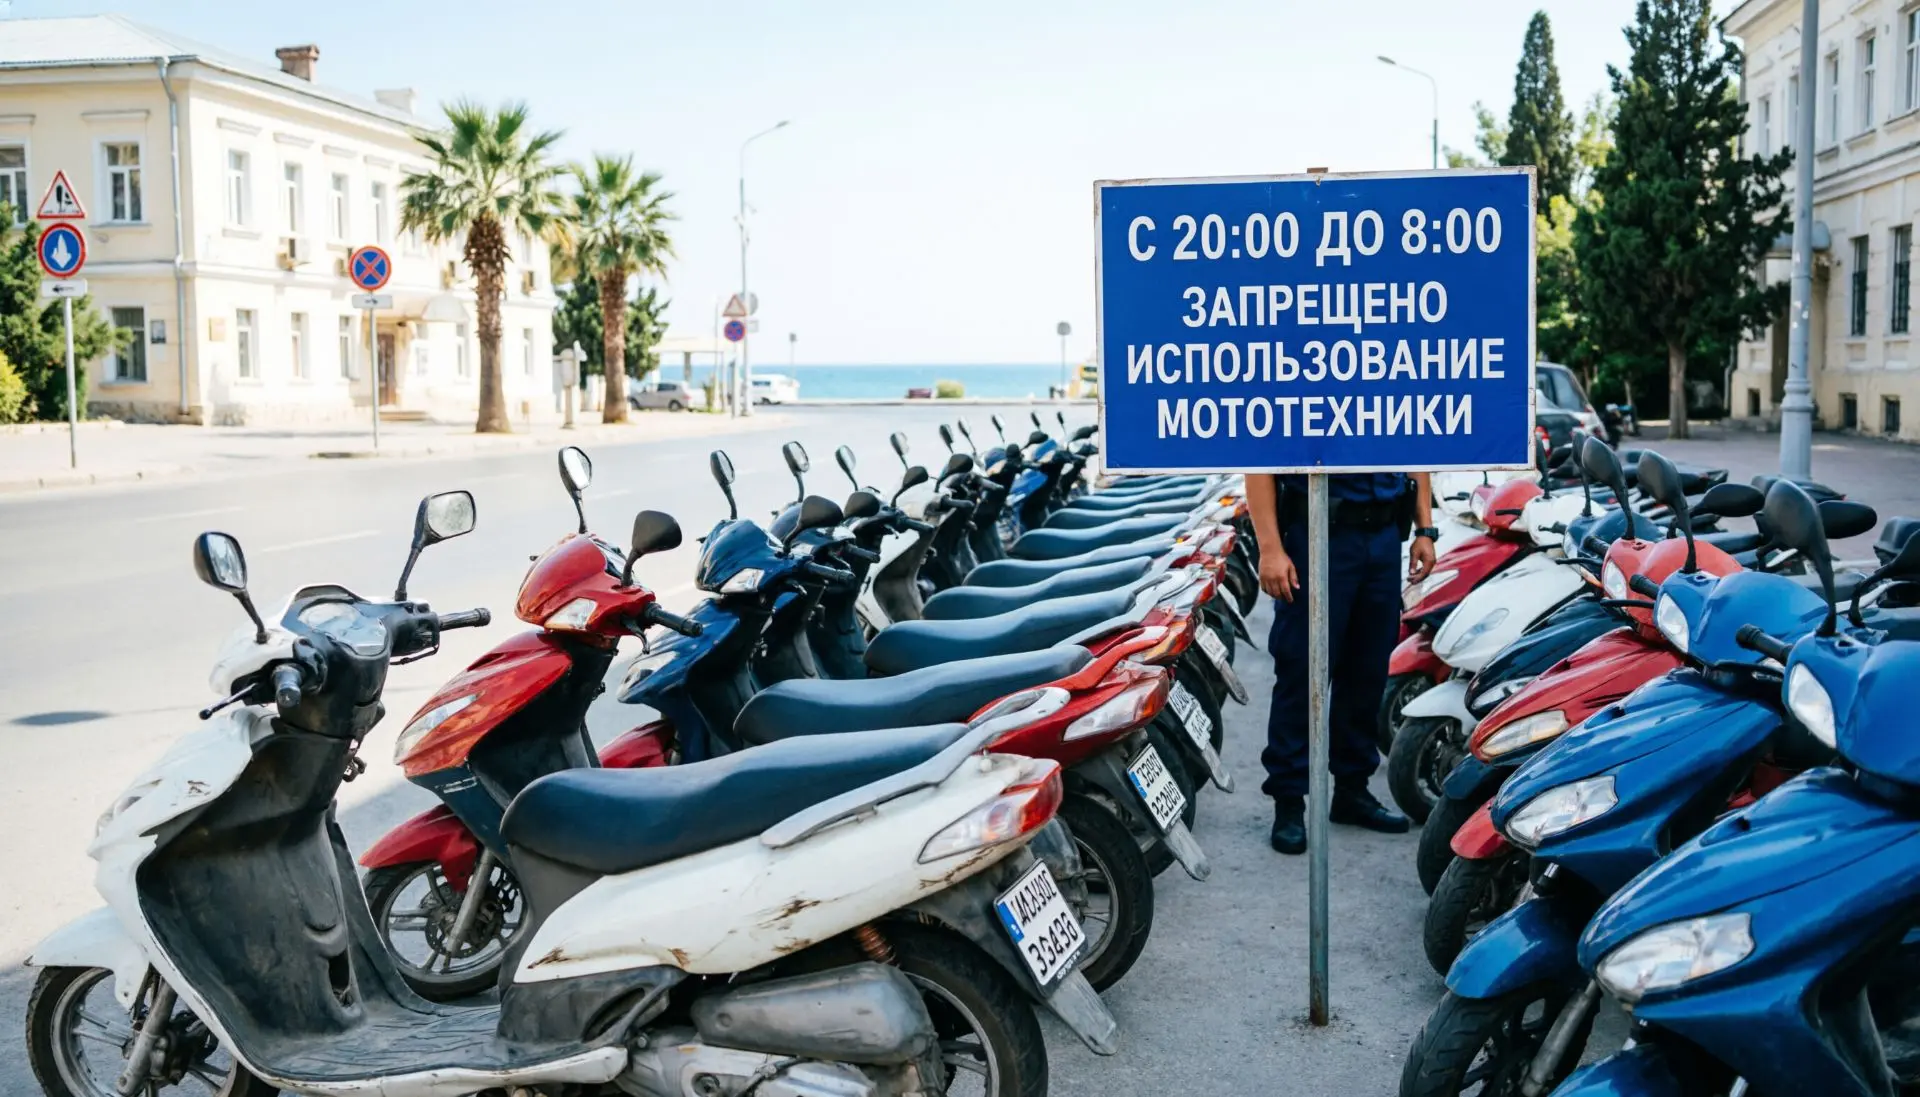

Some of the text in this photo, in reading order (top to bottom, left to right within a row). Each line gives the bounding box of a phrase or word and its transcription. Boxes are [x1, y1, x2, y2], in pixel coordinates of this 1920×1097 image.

[1128, 206, 1502, 267] С 20:00 ДО 8:00
[1182, 280, 1448, 334] ЗАПРЕЩЕНО
[1127, 337, 1505, 385] ИСПОЛЬЗОВАНИЕ
[1157, 394, 1472, 439] МОТОТЕХНИКИ
